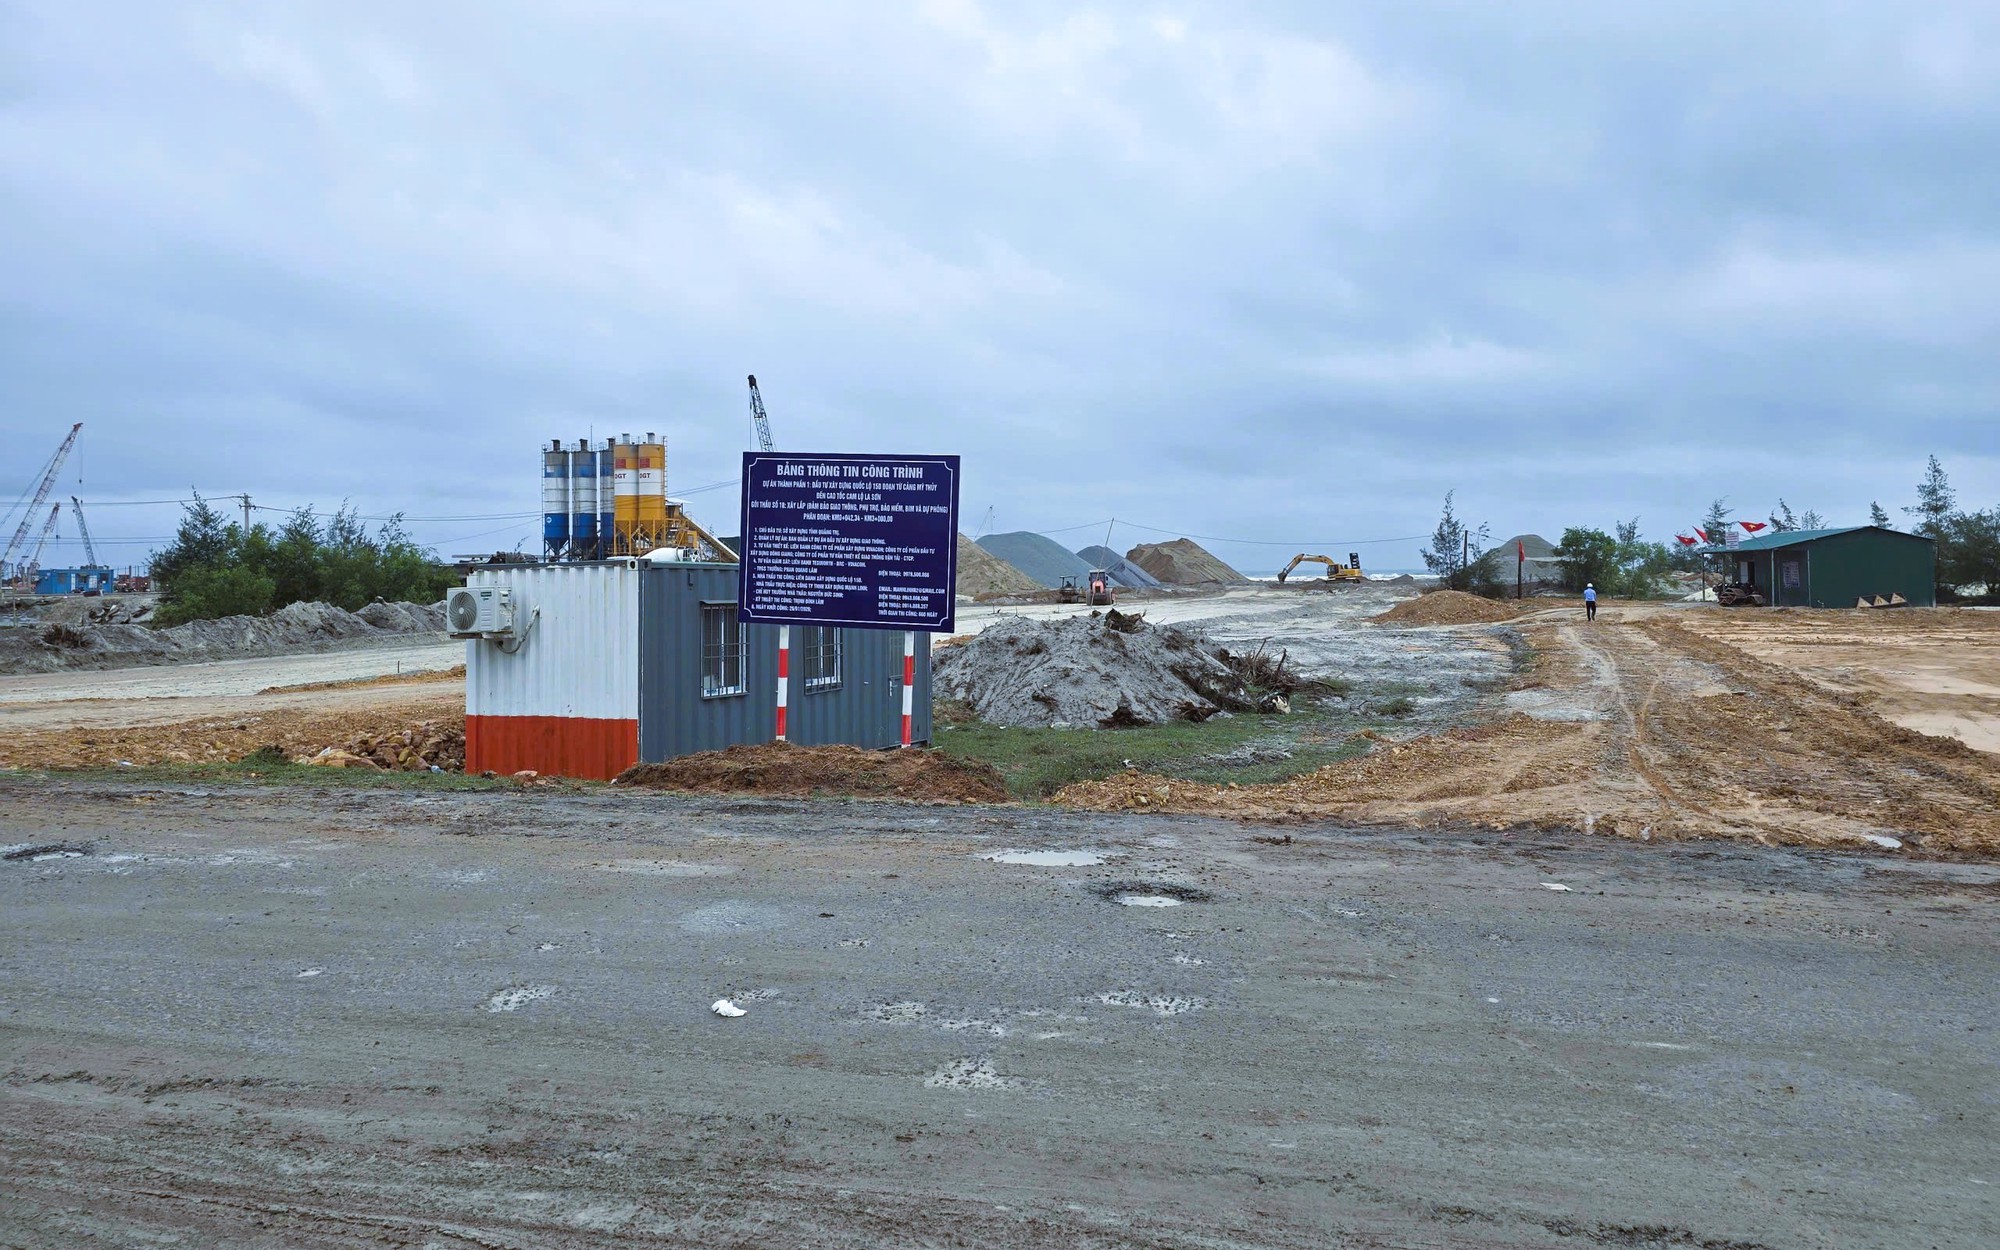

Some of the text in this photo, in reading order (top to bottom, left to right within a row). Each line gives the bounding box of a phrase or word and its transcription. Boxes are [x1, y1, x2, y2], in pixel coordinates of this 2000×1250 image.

[777, 462, 923, 478] BẢNG THÔNG TIN CÔNG TRÌNH
[763, 480, 770, 488] DỰ
[793, 479, 806, 488] PHẦN
[812, 480, 821, 488] ĐẦU
[840, 481, 851, 490] DỰNG
[853, 480, 865, 490] QUỐC
[866, 482, 871, 491] LỘ
[896, 482, 903, 490] TỪ
[903, 482, 916, 491] CẢNG
[917, 483, 924, 491] MỸ
[926, 482, 937, 491] THỦY
[837, 491, 845, 499] TỐC
[858, 493, 863, 501] LỘ
